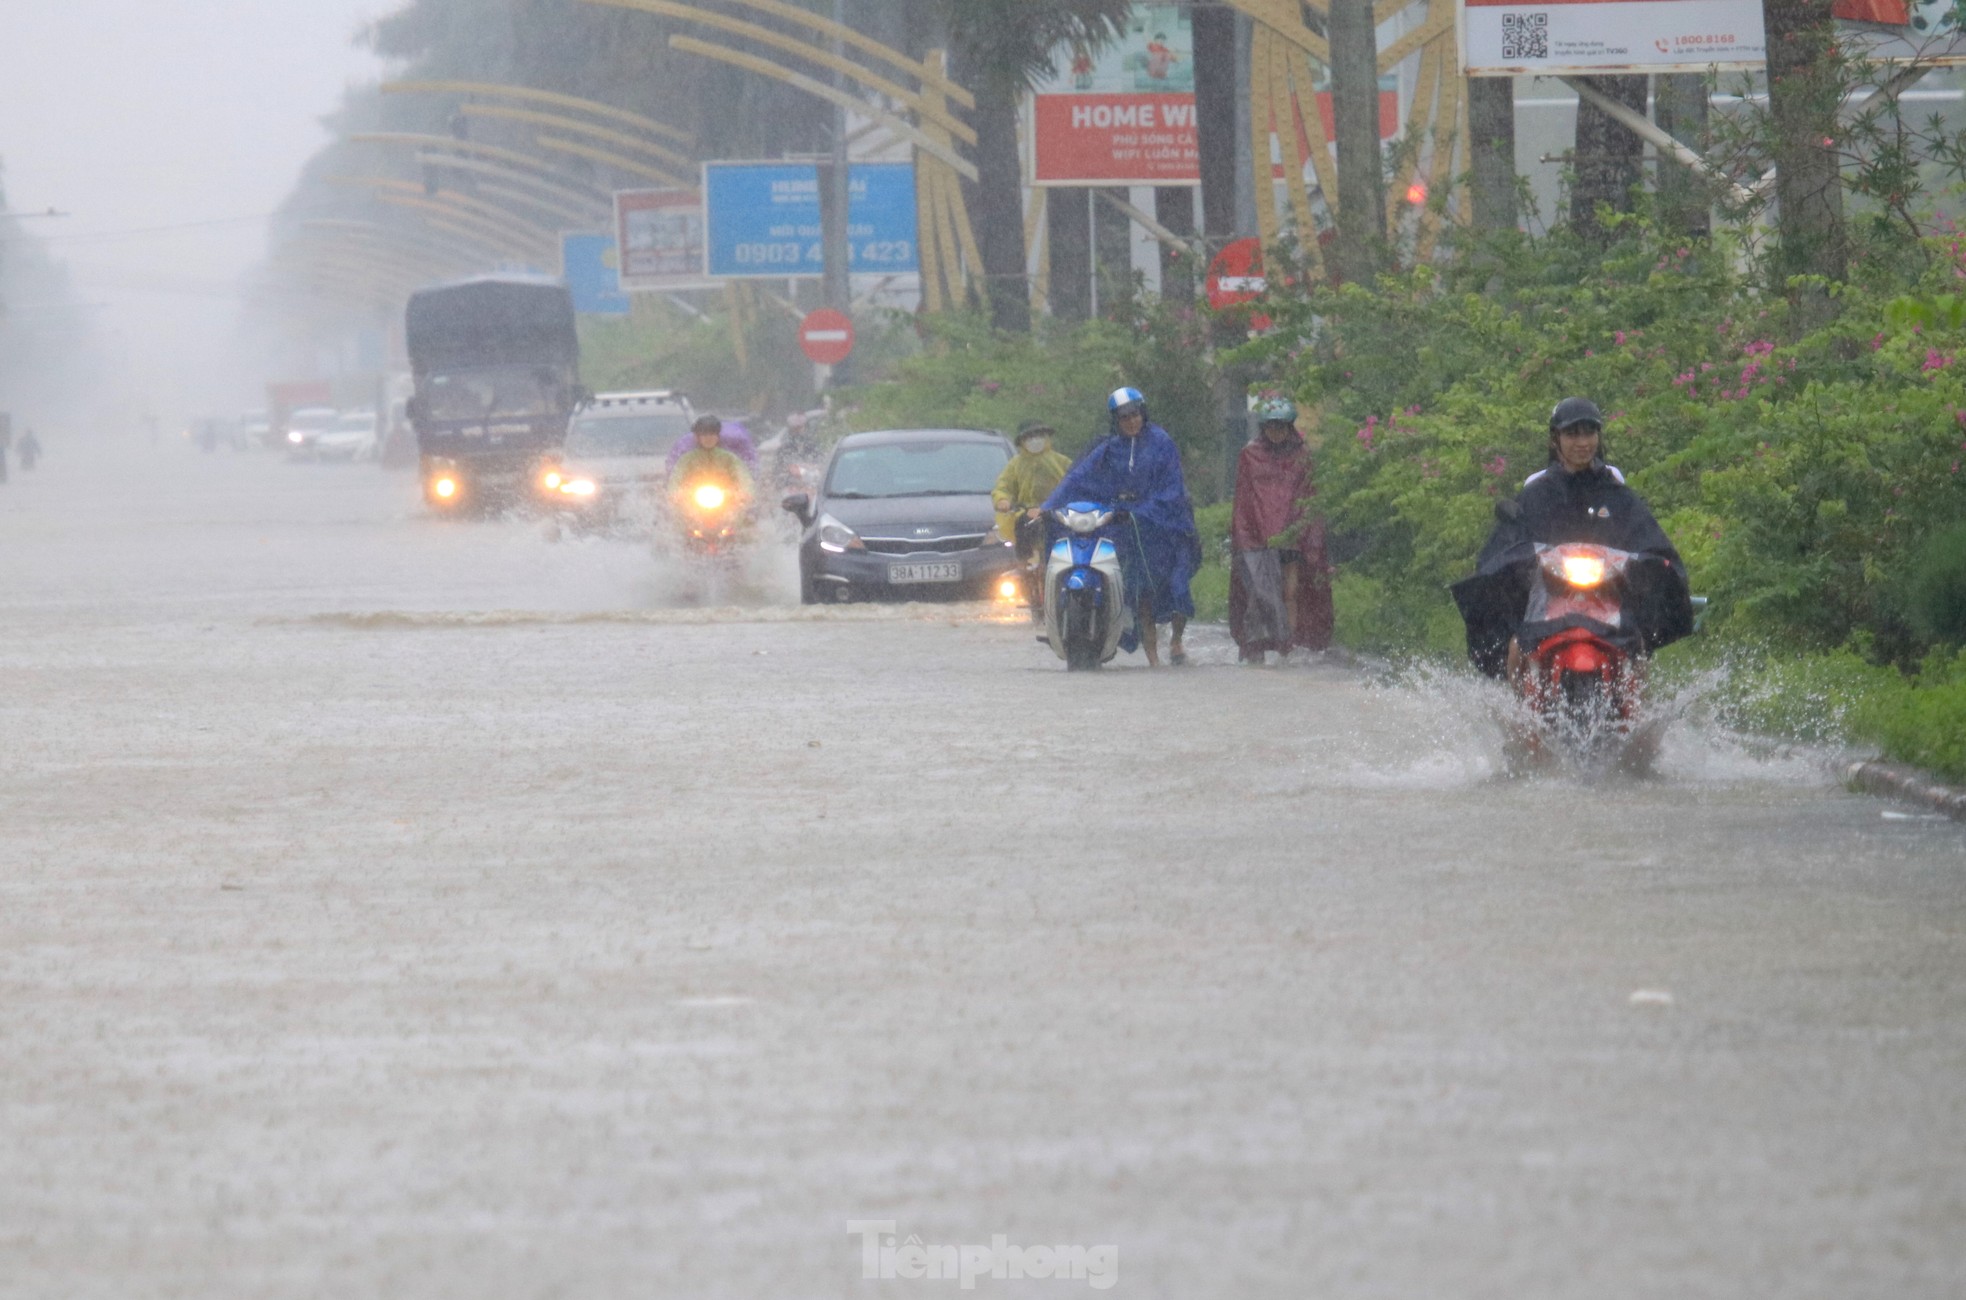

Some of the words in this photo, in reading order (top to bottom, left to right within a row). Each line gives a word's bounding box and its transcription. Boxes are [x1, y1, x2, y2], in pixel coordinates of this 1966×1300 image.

[1675, 34, 1735, 45] 1800.8168
[1071, 103, 1154, 128] HOME
[735, 242, 800, 264] 0903
[862, 240, 912, 262] 423
